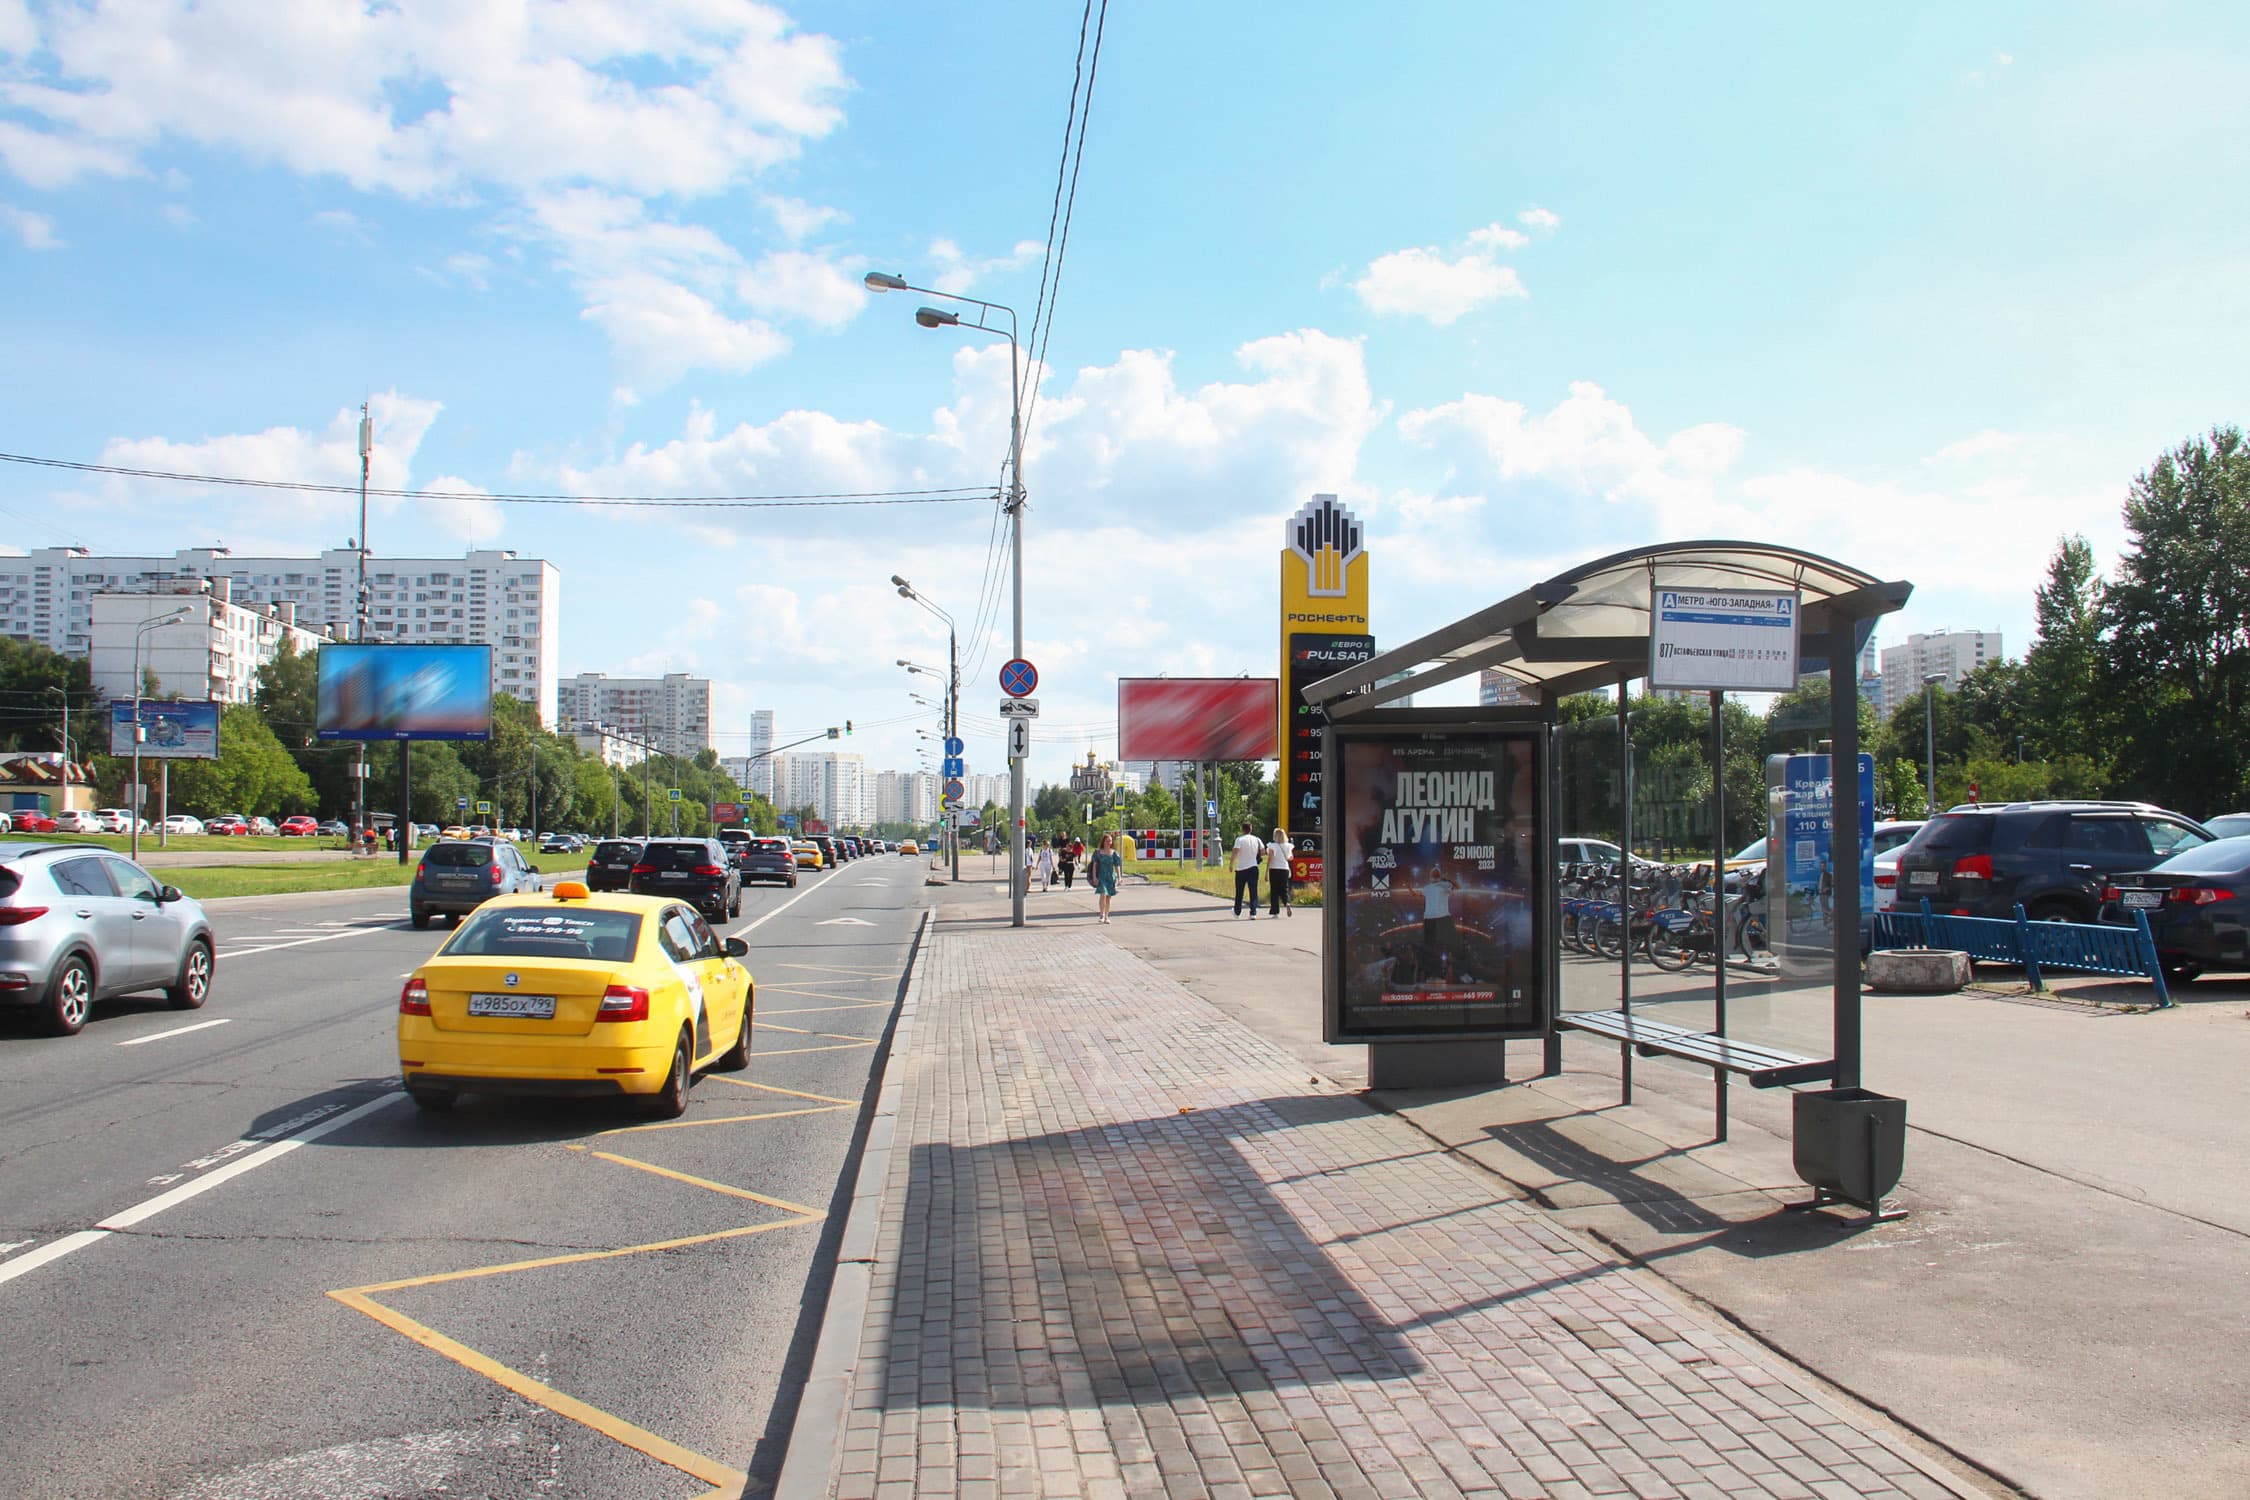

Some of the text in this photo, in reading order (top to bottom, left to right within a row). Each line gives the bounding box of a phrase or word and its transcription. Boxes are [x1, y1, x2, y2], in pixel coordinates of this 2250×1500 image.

[1678, 595, 1704, 606] МЕТРО
[1288, 613, 1365, 623] РОСНЕФТЬ
[1338, 641, 1362, 649] ЕВРО
[1307, 650, 1369, 661] PULSAR
[1660, 643, 1674, 658] 877
[1310, 706, 1322, 714] 95
[1310, 729, 1322, 737] 95
[1310, 751, 1322, 760] 10
[1395, 771, 1495, 811] ЛЕОНИД
[1381, 808, 1475, 844] АГУТИН
[1799, 821, 1816, 830] 110
[1453, 846, 1495, 859] 29 ИЮЛЯ
[1296, 862, 1308, 877] 3
[1478, 860, 1495, 869] 2023
[517, 926, 584, 935] 999-99-99
[472, 997, 551, 1012] Н985ОХ 799
